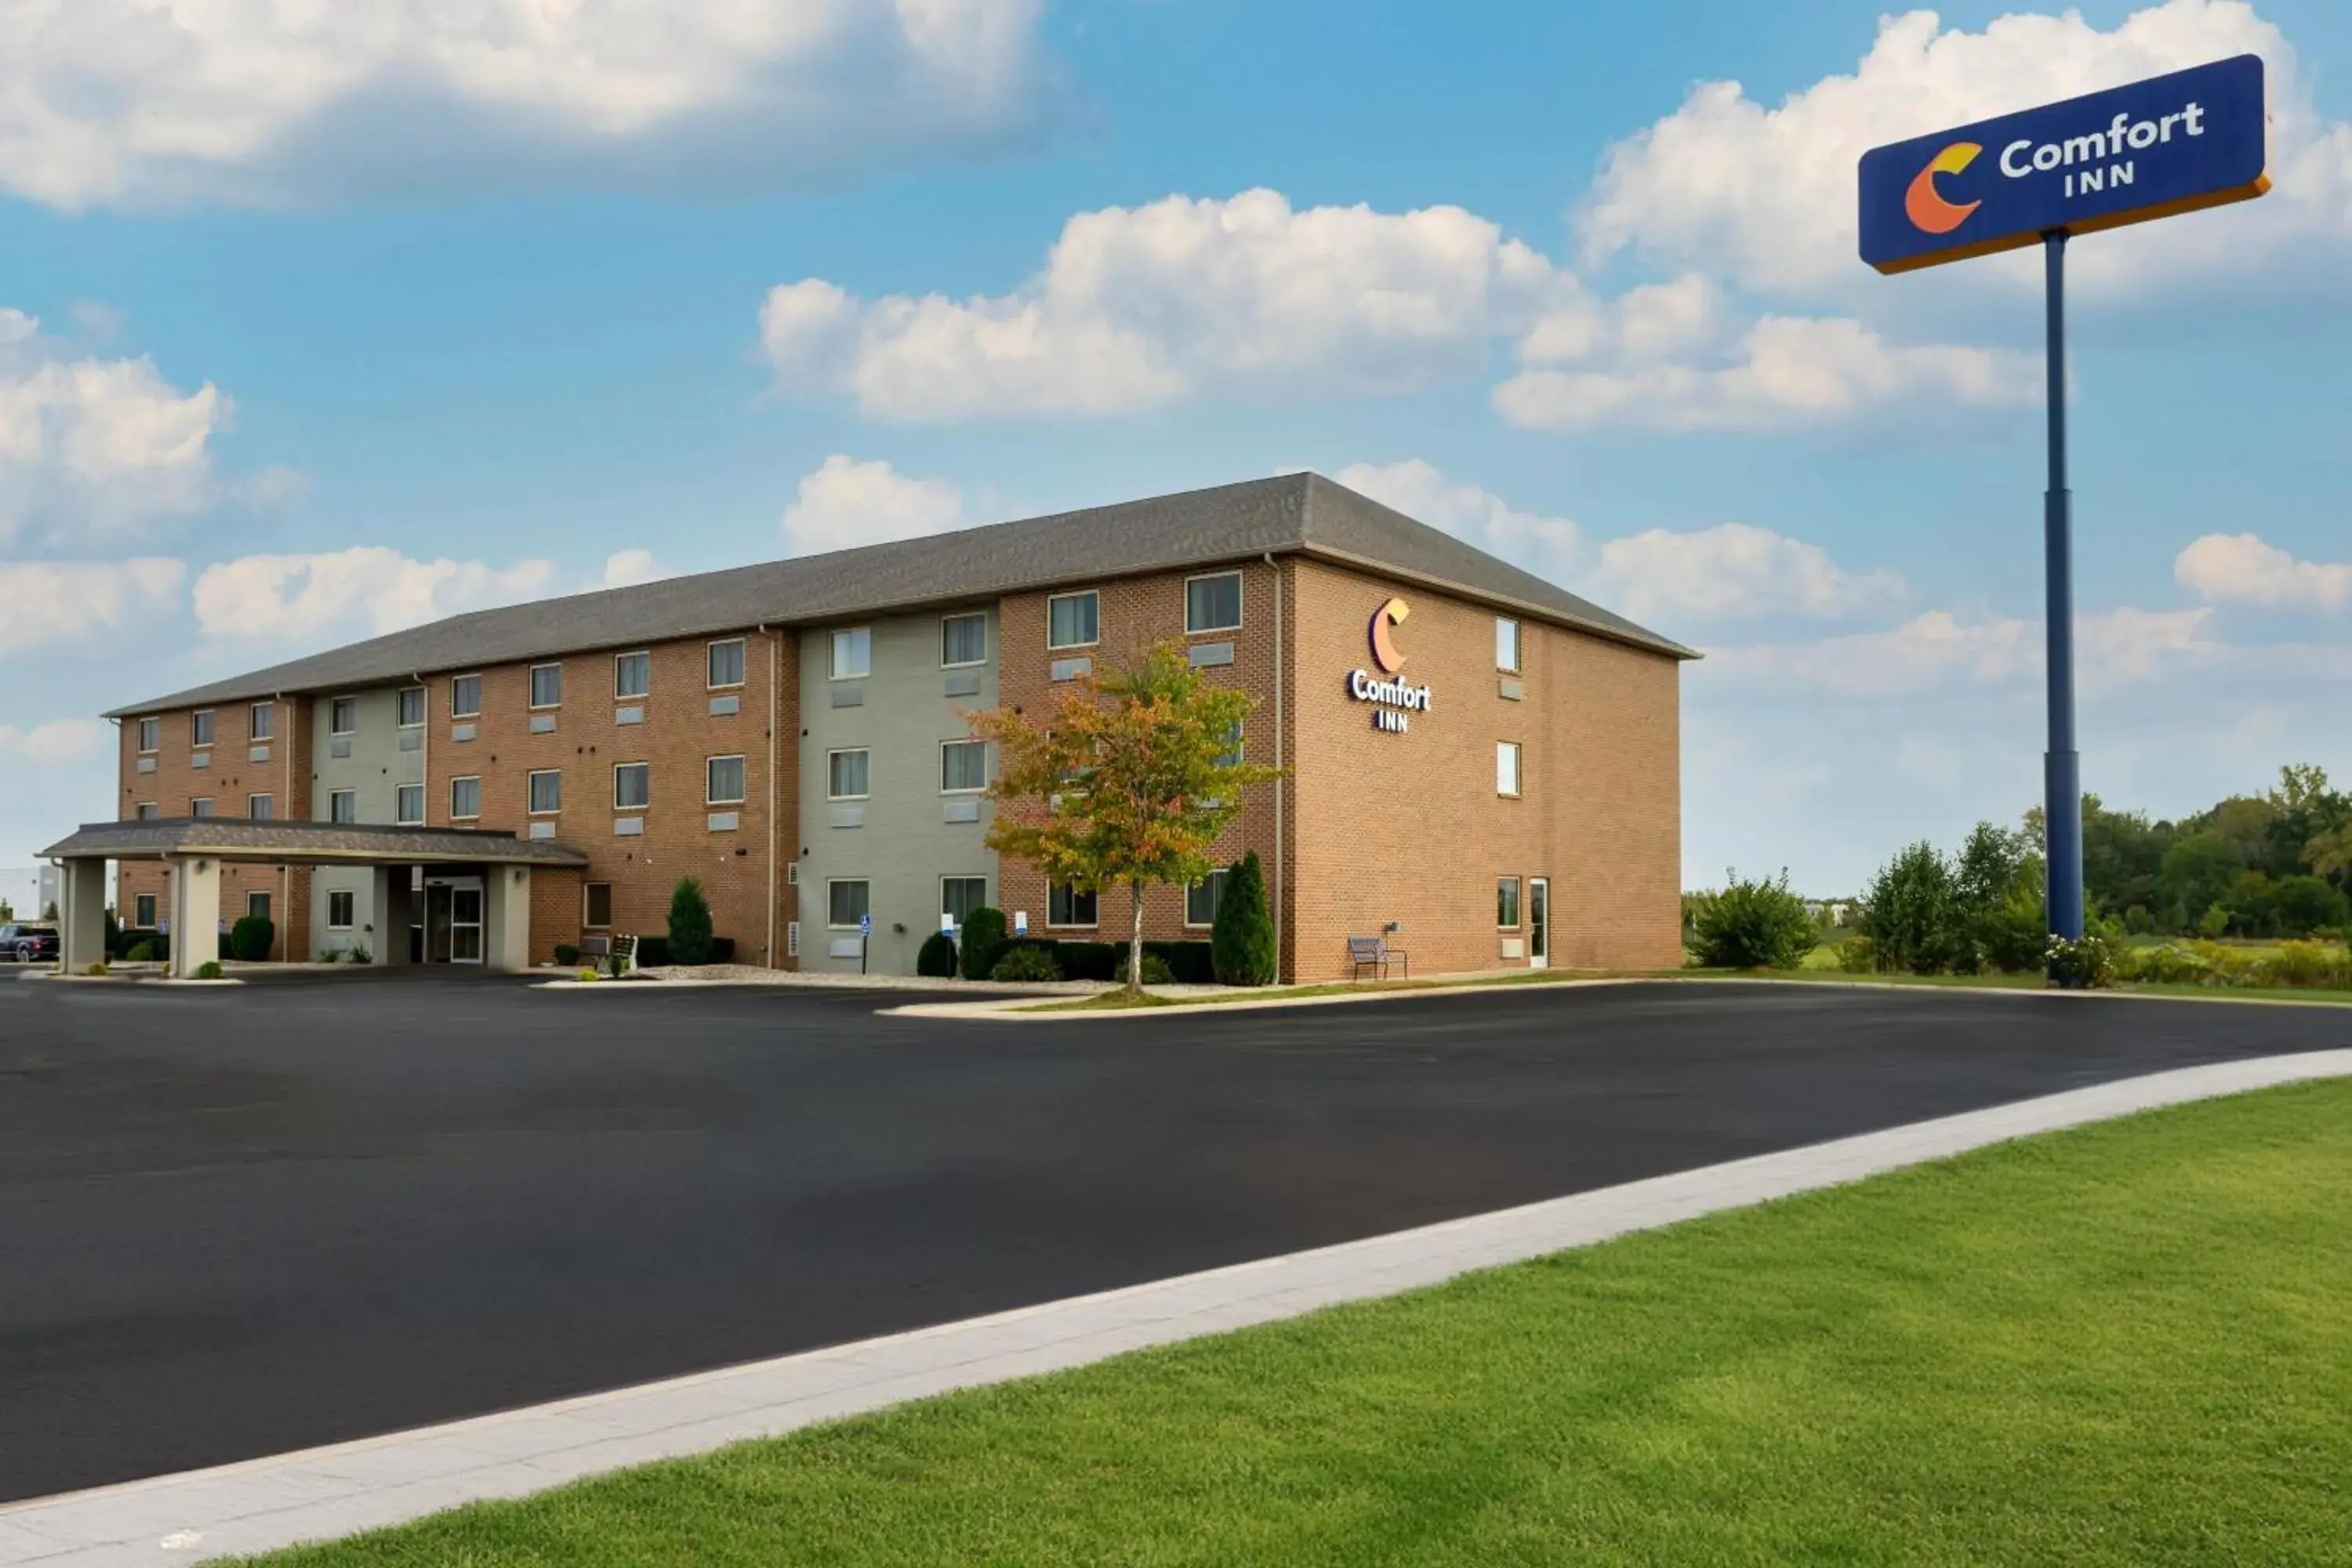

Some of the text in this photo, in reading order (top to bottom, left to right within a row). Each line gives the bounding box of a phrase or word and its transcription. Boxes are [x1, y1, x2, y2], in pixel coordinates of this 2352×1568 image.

[2000, 102, 2205, 178] Comfort
[2064, 162, 2134, 198] INN
[1349, 669, 1432, 711] Comfort
[1377, 710, 1408, 733] INN
